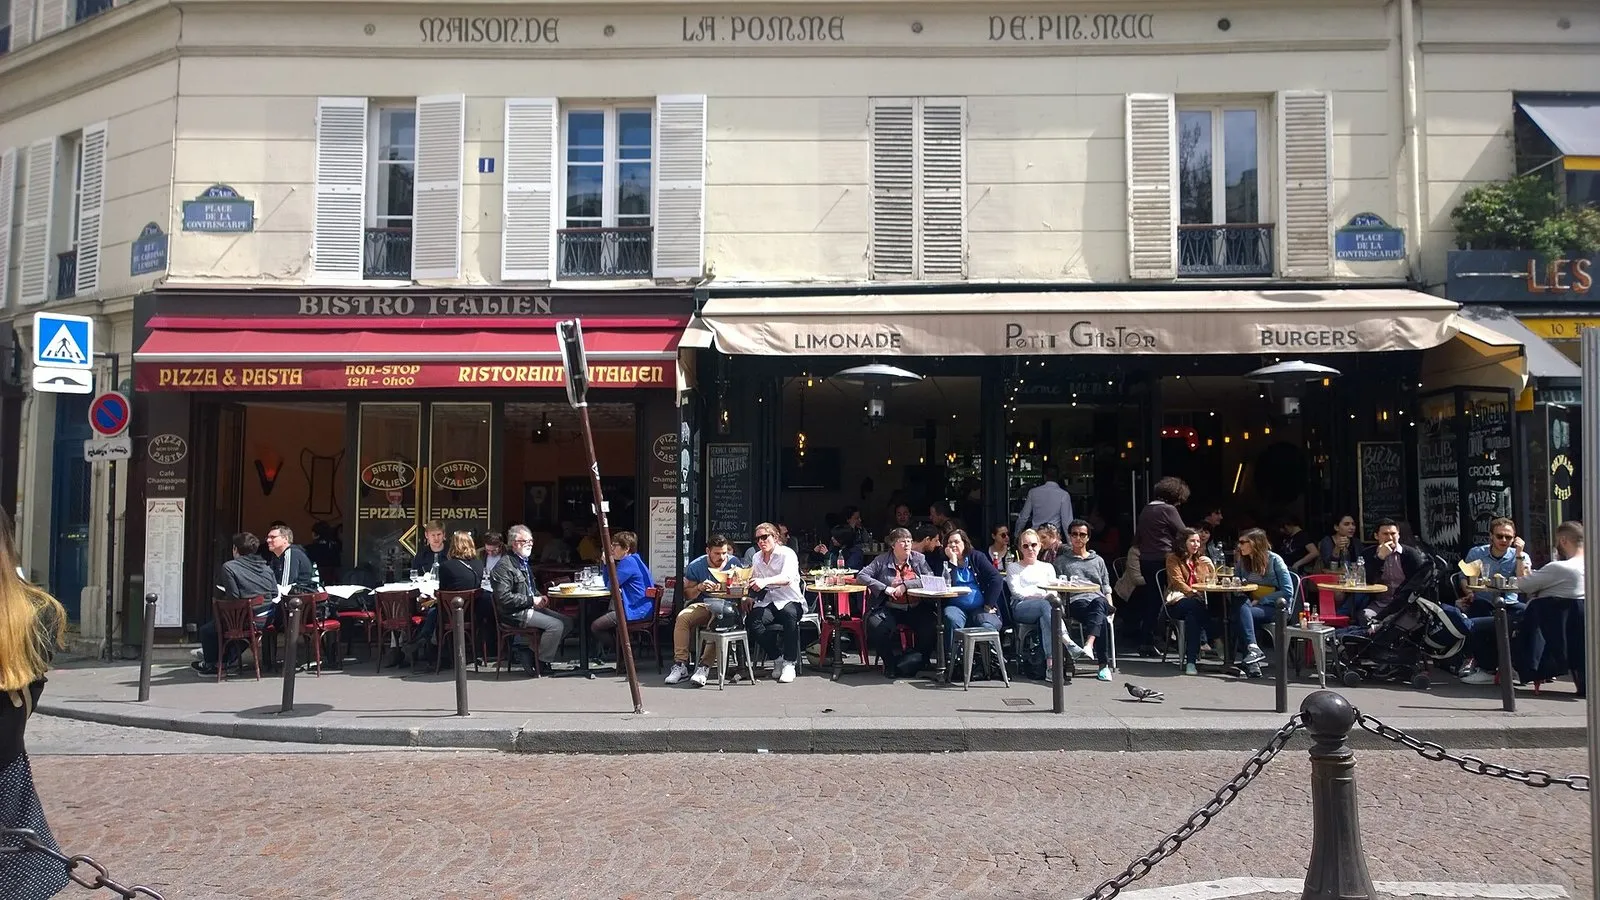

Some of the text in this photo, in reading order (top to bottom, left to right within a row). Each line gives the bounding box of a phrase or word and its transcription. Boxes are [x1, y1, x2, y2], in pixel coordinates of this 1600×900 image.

[205, 204, 232, 213] PLACE
[187, 221, 248, 229] CONTRESCARPE
[1355, 233, 1384, 242] PLACE
[1357, 242, 1381, 250] DE LA
[1337, 250, 1400, 258] CONTRESCARPE
[1528, 257, 1593, 294] LES
[298, 295, 553, 315] BISTRO ITALIEN
[794, 333, 901, 348] LIMONADE
[1261, 330, 1358, 346] BURGERS
[345, 365, 421, 375] NON-STOP
[458, 366, 664, 382] RISTORANT ITALIEN
[159, 368, 303, 386] PIZZA & PASTA
[347, 376, 367, 386] 12h
[1539, 390, 1575, 403] PUB
[154, 435, 181, 446] PIZZA
[153, 451, 182, 462] PASTA
[371, 464, 406, 475] BISTRO
[442, 463, 477, 474] BISTRO
[1468, 463, 1501, 476] CROQUE
[147, 477, 186, 485] Champagne
[371, 477, 407, 488] ITALIEN
[442, 476, 478, 487] ITALIEN
[1473, 491, 1497, 505] TAPAS
[369, 508, 406, 518] PIZZA
[441, 508, 478, 518] PASTA
